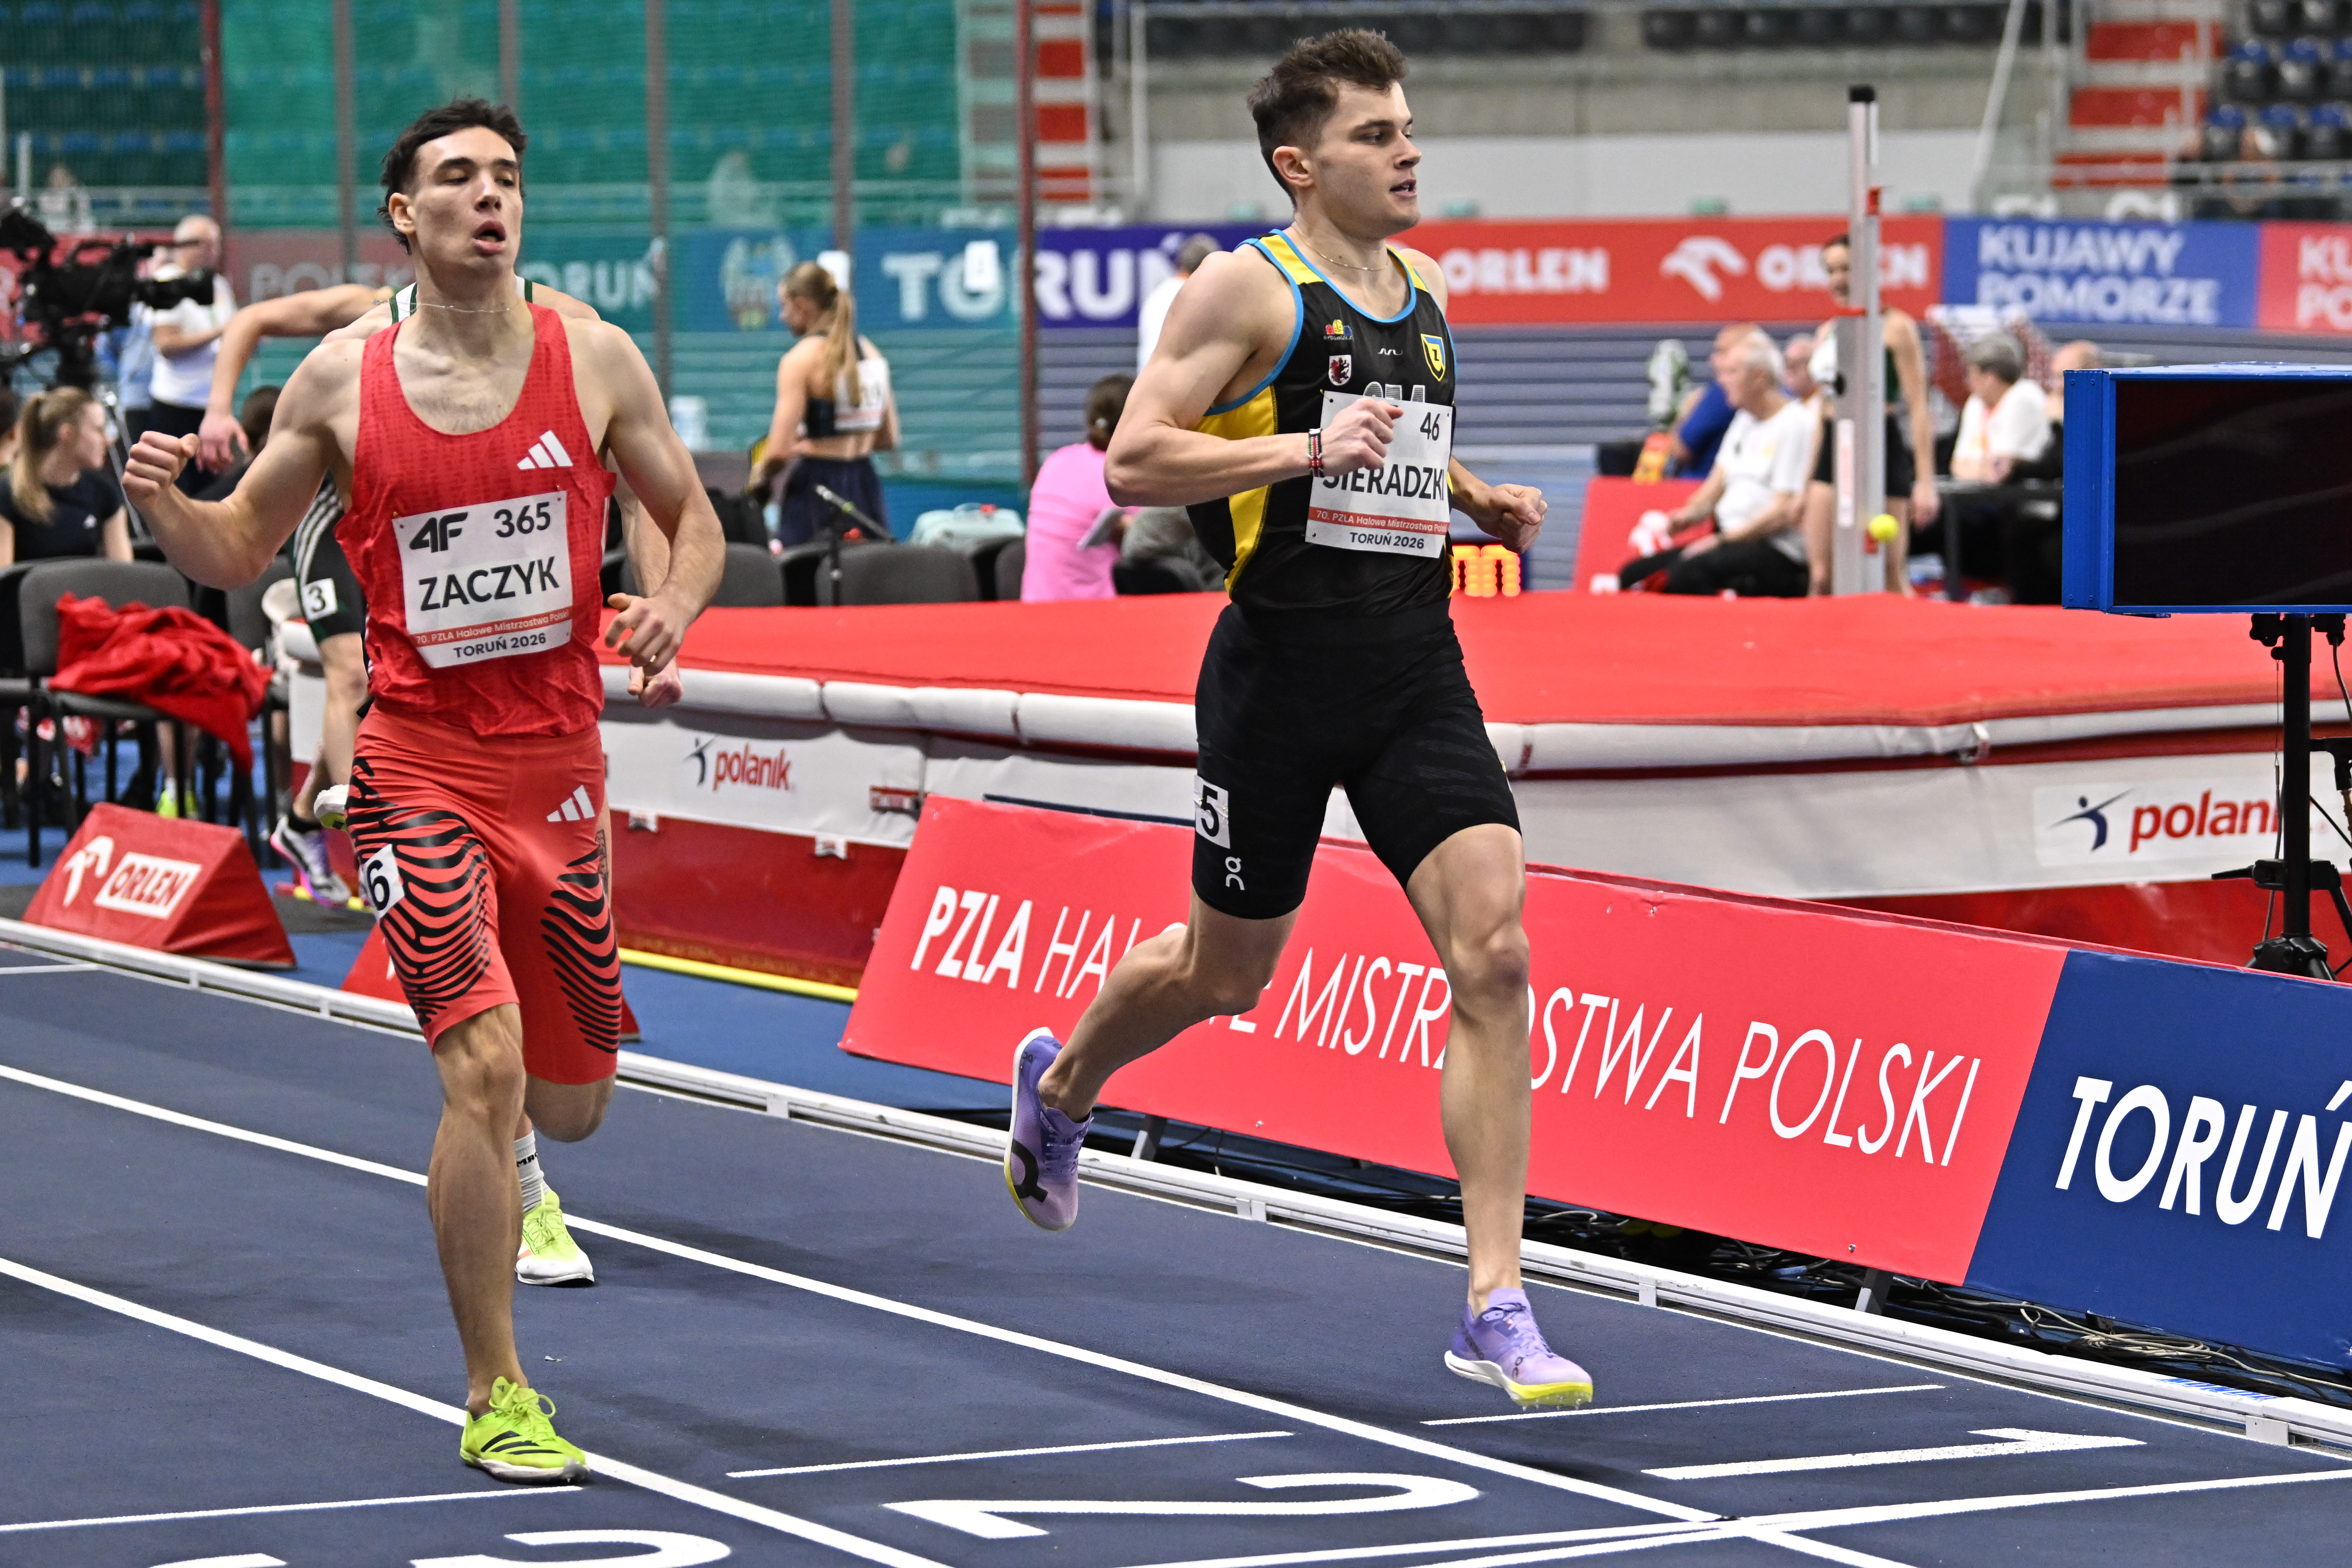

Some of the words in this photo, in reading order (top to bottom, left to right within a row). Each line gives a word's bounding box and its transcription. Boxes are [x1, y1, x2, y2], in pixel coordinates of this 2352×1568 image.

[1440, 247, 1610, 295] ORLEN
[1978, 225, 2184, 276] KUJAWY
[1976, 271, 2220, 324] POMORZE
[1420, 412, 1440, 440] 46
[409, 512, 468, 553] 4F
[494, 501, 551, 538] 365
[1316, 510, 1329, 520] 70.
[1332, 513, 1354, 523] PZLA
[1356, 516, 1385, 526] Halowe
[1387, 519, 1432, 531] Mistrzostwa
[1350, 532, 1391, 545] TORUŃ
[1393, 536, 1424, 549] 2026
[308, 587, 326, 613] 3
[418, 556, 559, 611] ZACZYK
[416, 635, 430, 644] 70.
[431, 633, 454, 642] PZLA
[456, 626, 492, 638] Halowe
[494, 617, 549, 632] Mistrzostwa
[453, 636, 506, 658] TORUŃ
[511, 633, 546, 649] 2026
[713, 743, 792, 791] polanik
[1200, 784, 1219, 837] 5
[2129, 789, 2312, 853] polan
[108, 864, 189, 907] ORLEN
[366, 860, 390, 911] 6
[910, 885, 1033, 989] PZLA
[1274, 947, 1703, 1118] MISTRSTWA
[1719, 1020, 1981, 1167] POLSKI
[2055, 1076, 2352, 1239] TORUŃ
[880, 1472, 1486, 1539] 2
